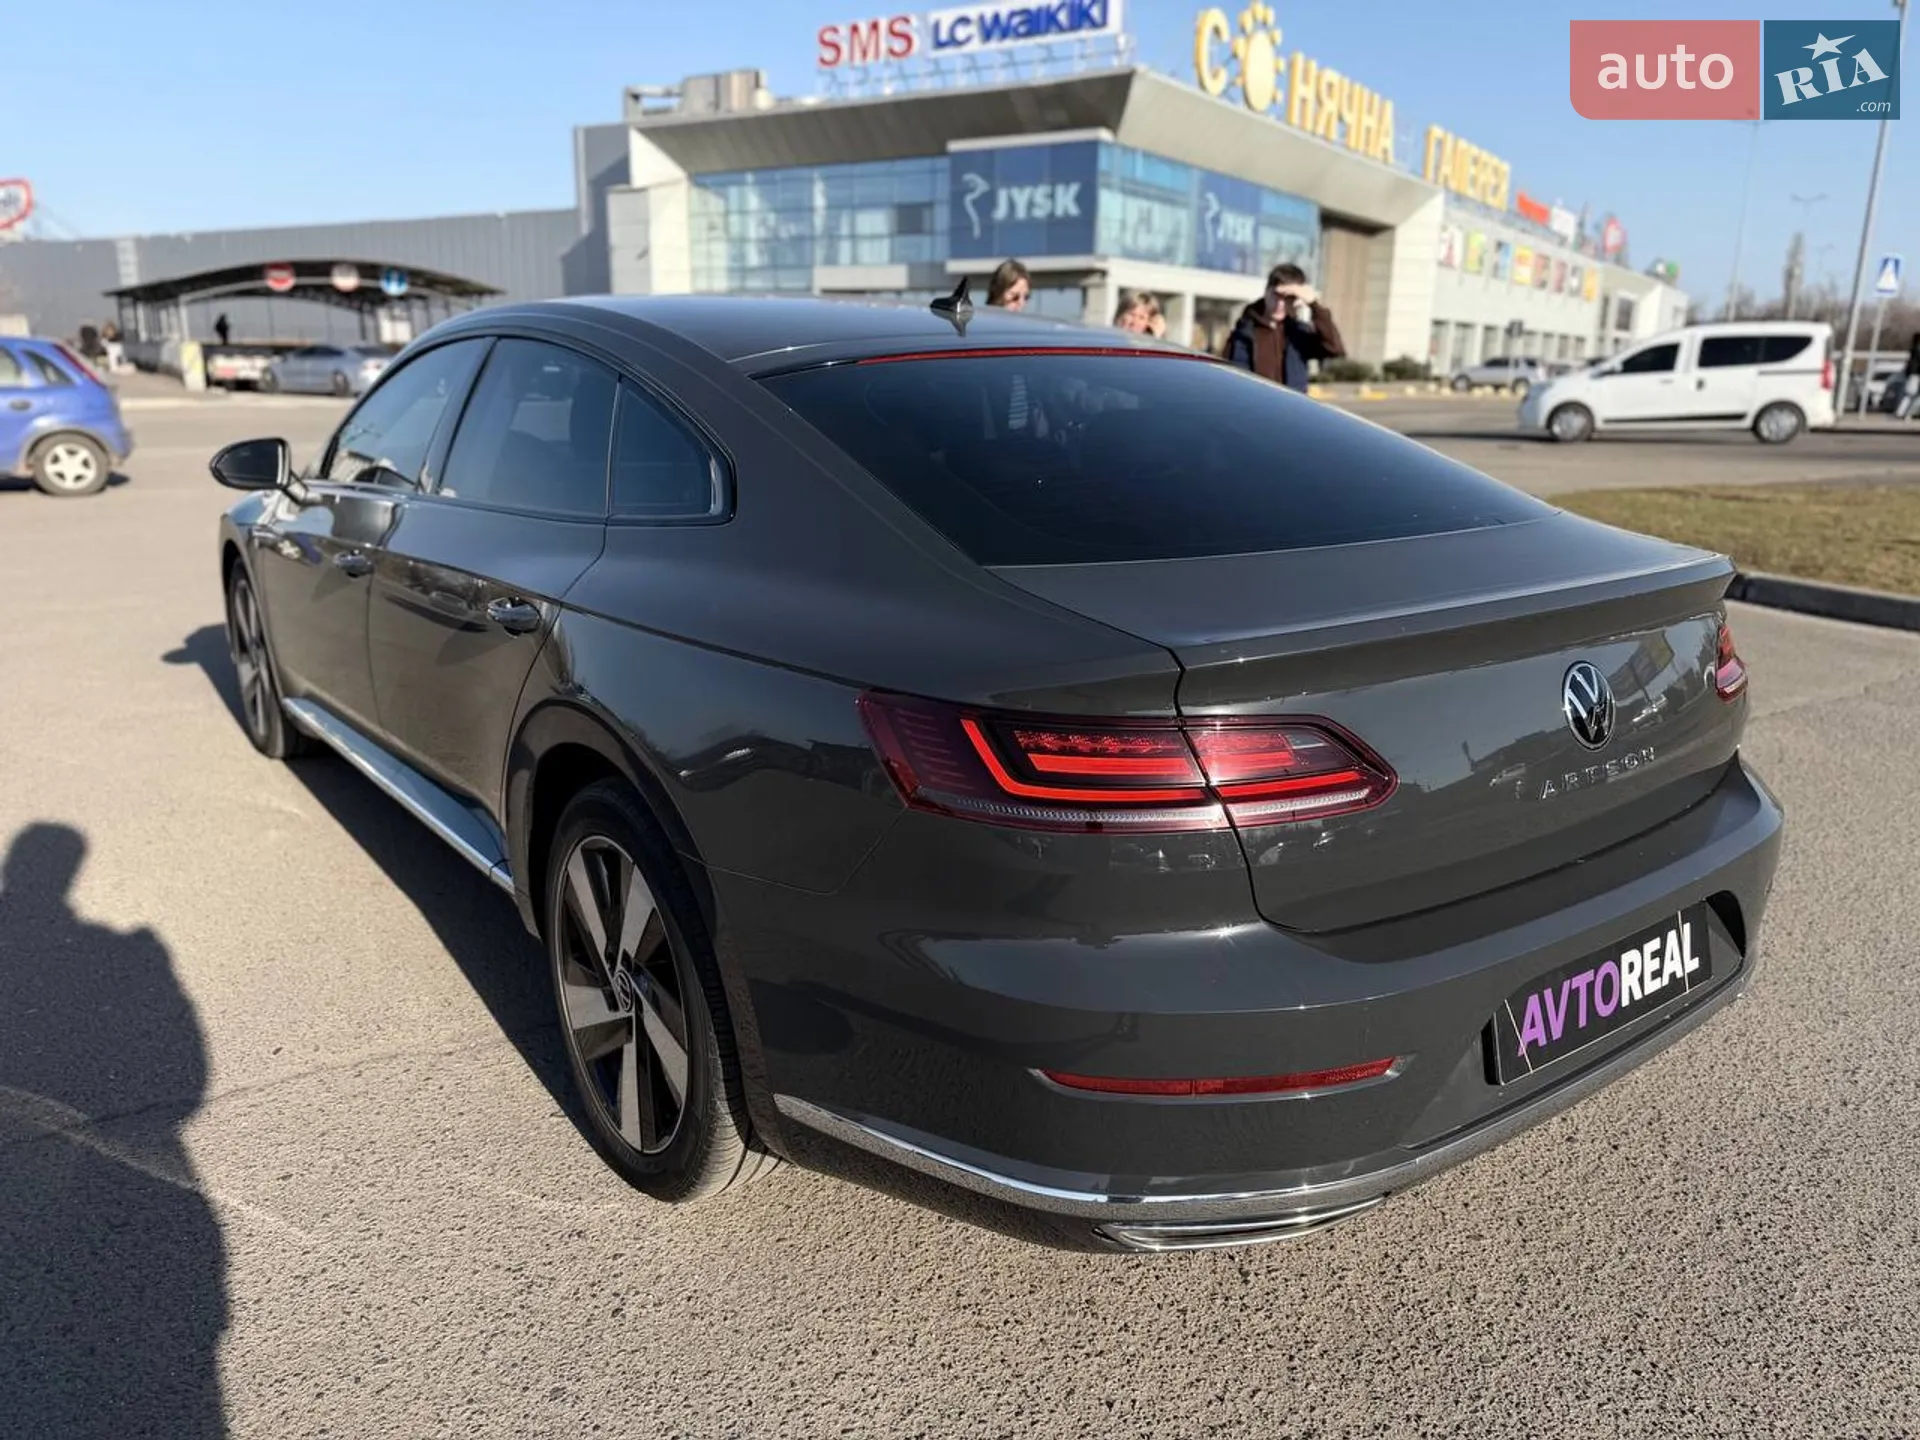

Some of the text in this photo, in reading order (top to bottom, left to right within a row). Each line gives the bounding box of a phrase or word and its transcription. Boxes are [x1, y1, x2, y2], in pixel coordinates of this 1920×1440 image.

[817, 15, 915, 67] SMS
[991, 183, 1081, 221] JYSK
[1517, 922, 1699, 1057] AVTOREAL
